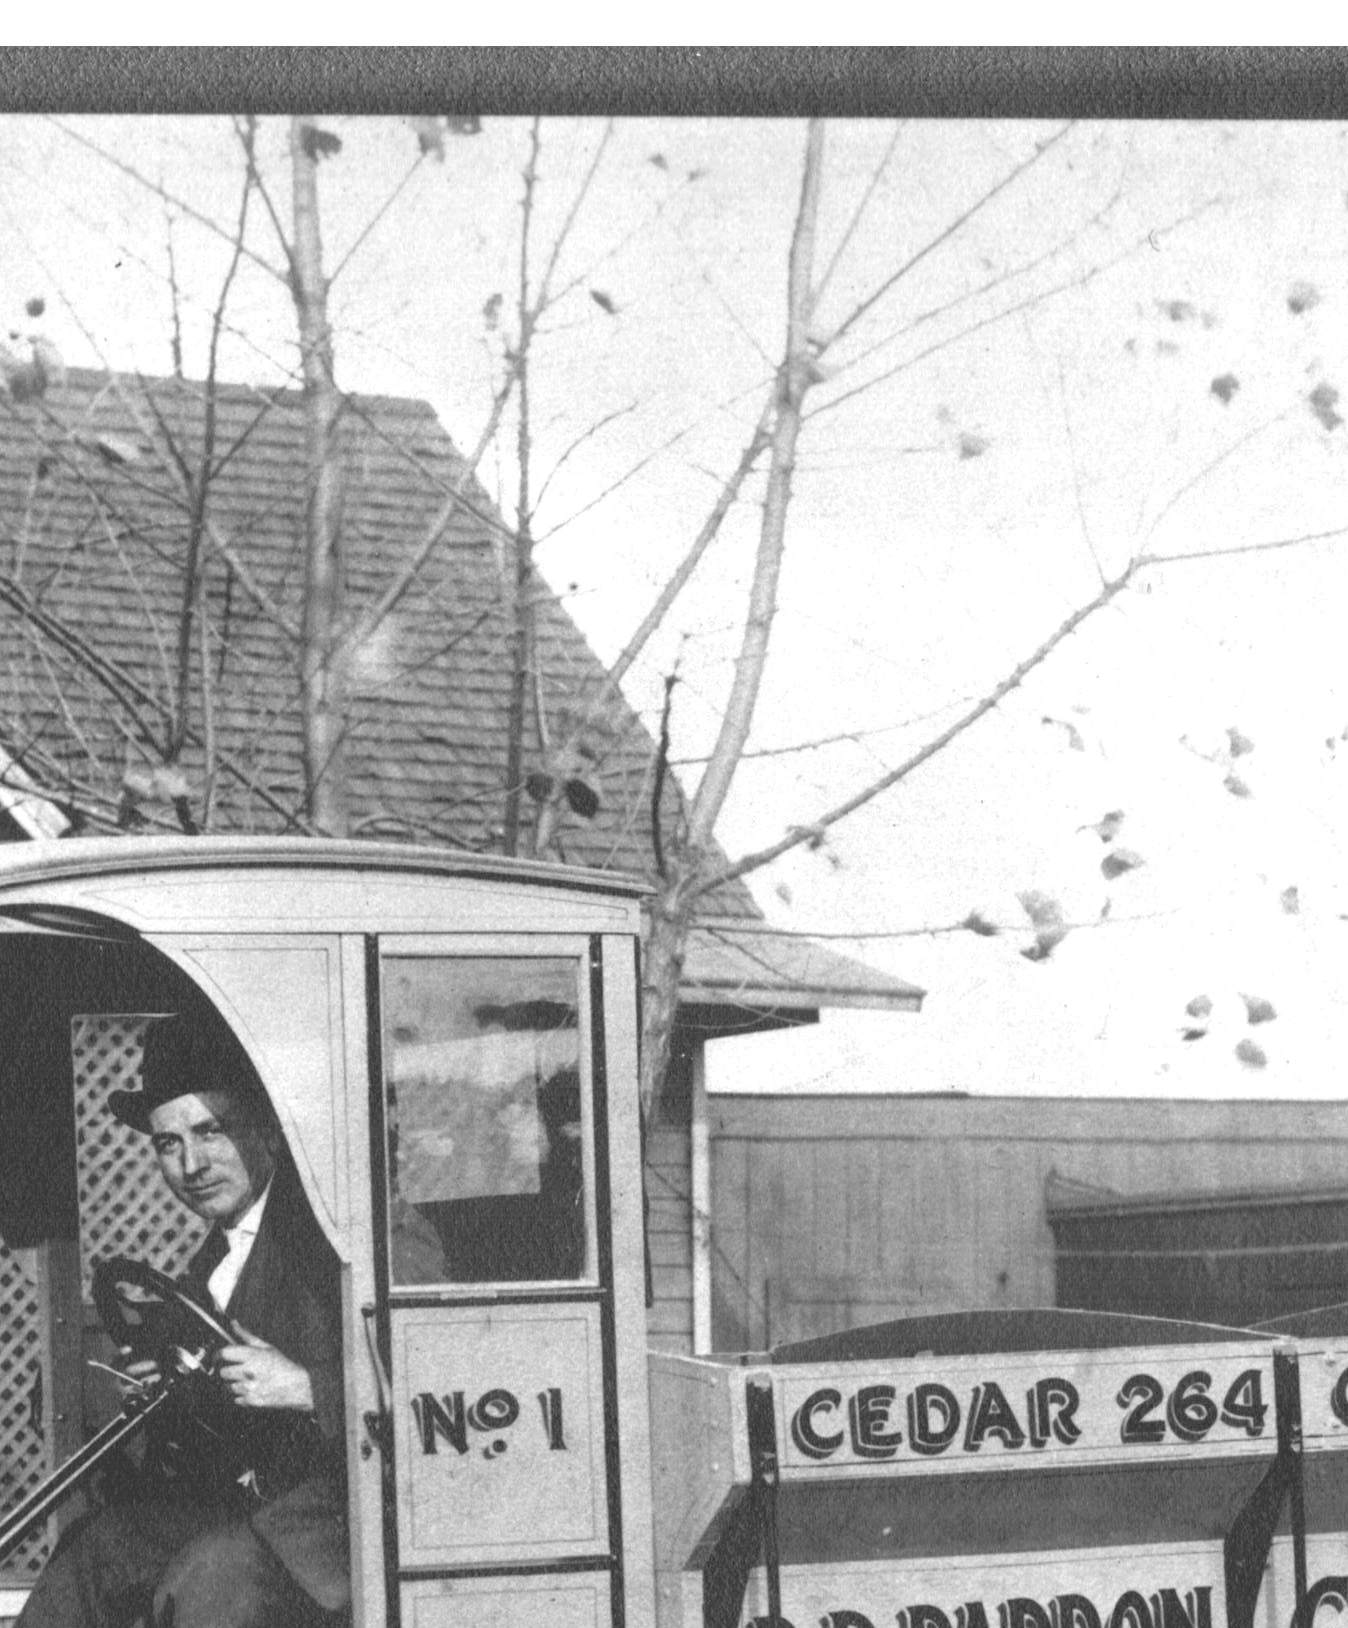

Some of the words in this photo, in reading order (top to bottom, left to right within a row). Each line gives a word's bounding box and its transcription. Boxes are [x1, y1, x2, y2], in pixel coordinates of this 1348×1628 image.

[536, 1387, 567, 1451] 1
[791, 1378, 1082, 1460] CEDAR
[1116, 1369, 1269, 1443] 264
